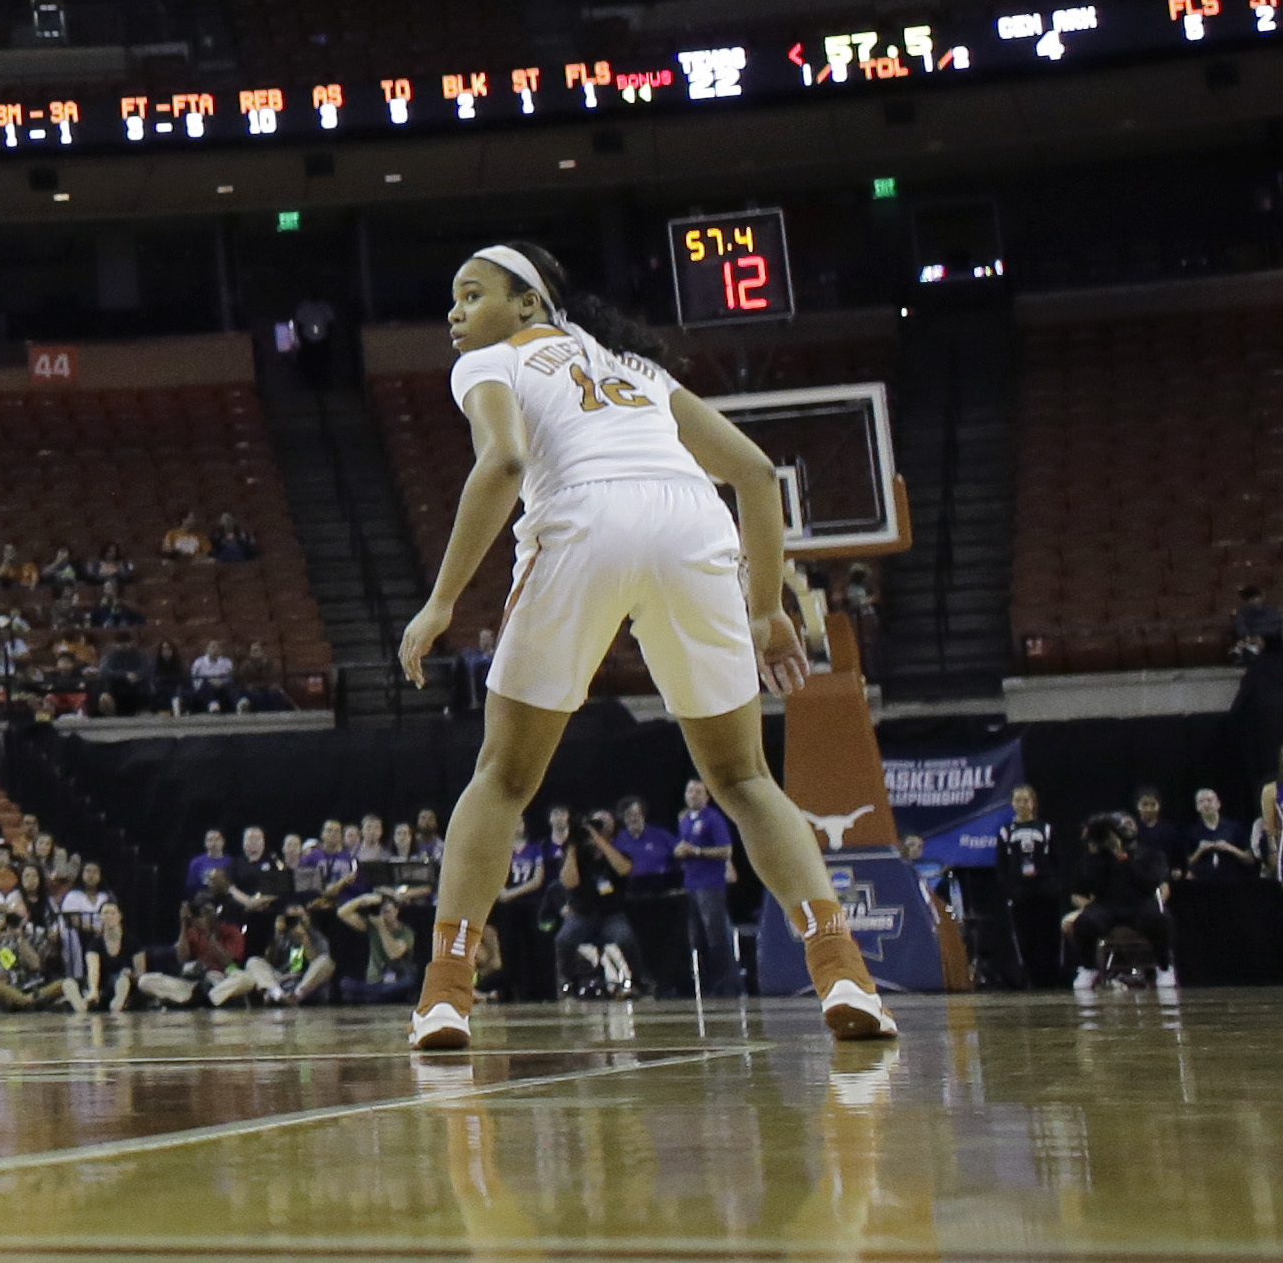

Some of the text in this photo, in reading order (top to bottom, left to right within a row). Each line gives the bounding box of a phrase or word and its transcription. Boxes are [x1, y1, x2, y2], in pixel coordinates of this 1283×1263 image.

[1036, 29, 1065, 60] 4
[1255, 5, 1277, 32] 2
[239, 88, 283, 114] REB
[312, 84, 343, 109] AS
[442, 72, 488, 99] BLK
[511, 68, 539, 93] ST
[565, 60, 613, 88] FLS
[248, 108, 277, 134] 10
[457, 92, 476, 119] 2
[521, 88, 534, 114] 1
[584, 82, 597, 108] 1
[689, 70, 742, 99] 22
[685, 226, 753, 262] 57.4
[723, 256, 768, 309] 12
[35, 354, 70, 378] 44
[885, 765, 995, 789] ASKETBALL
